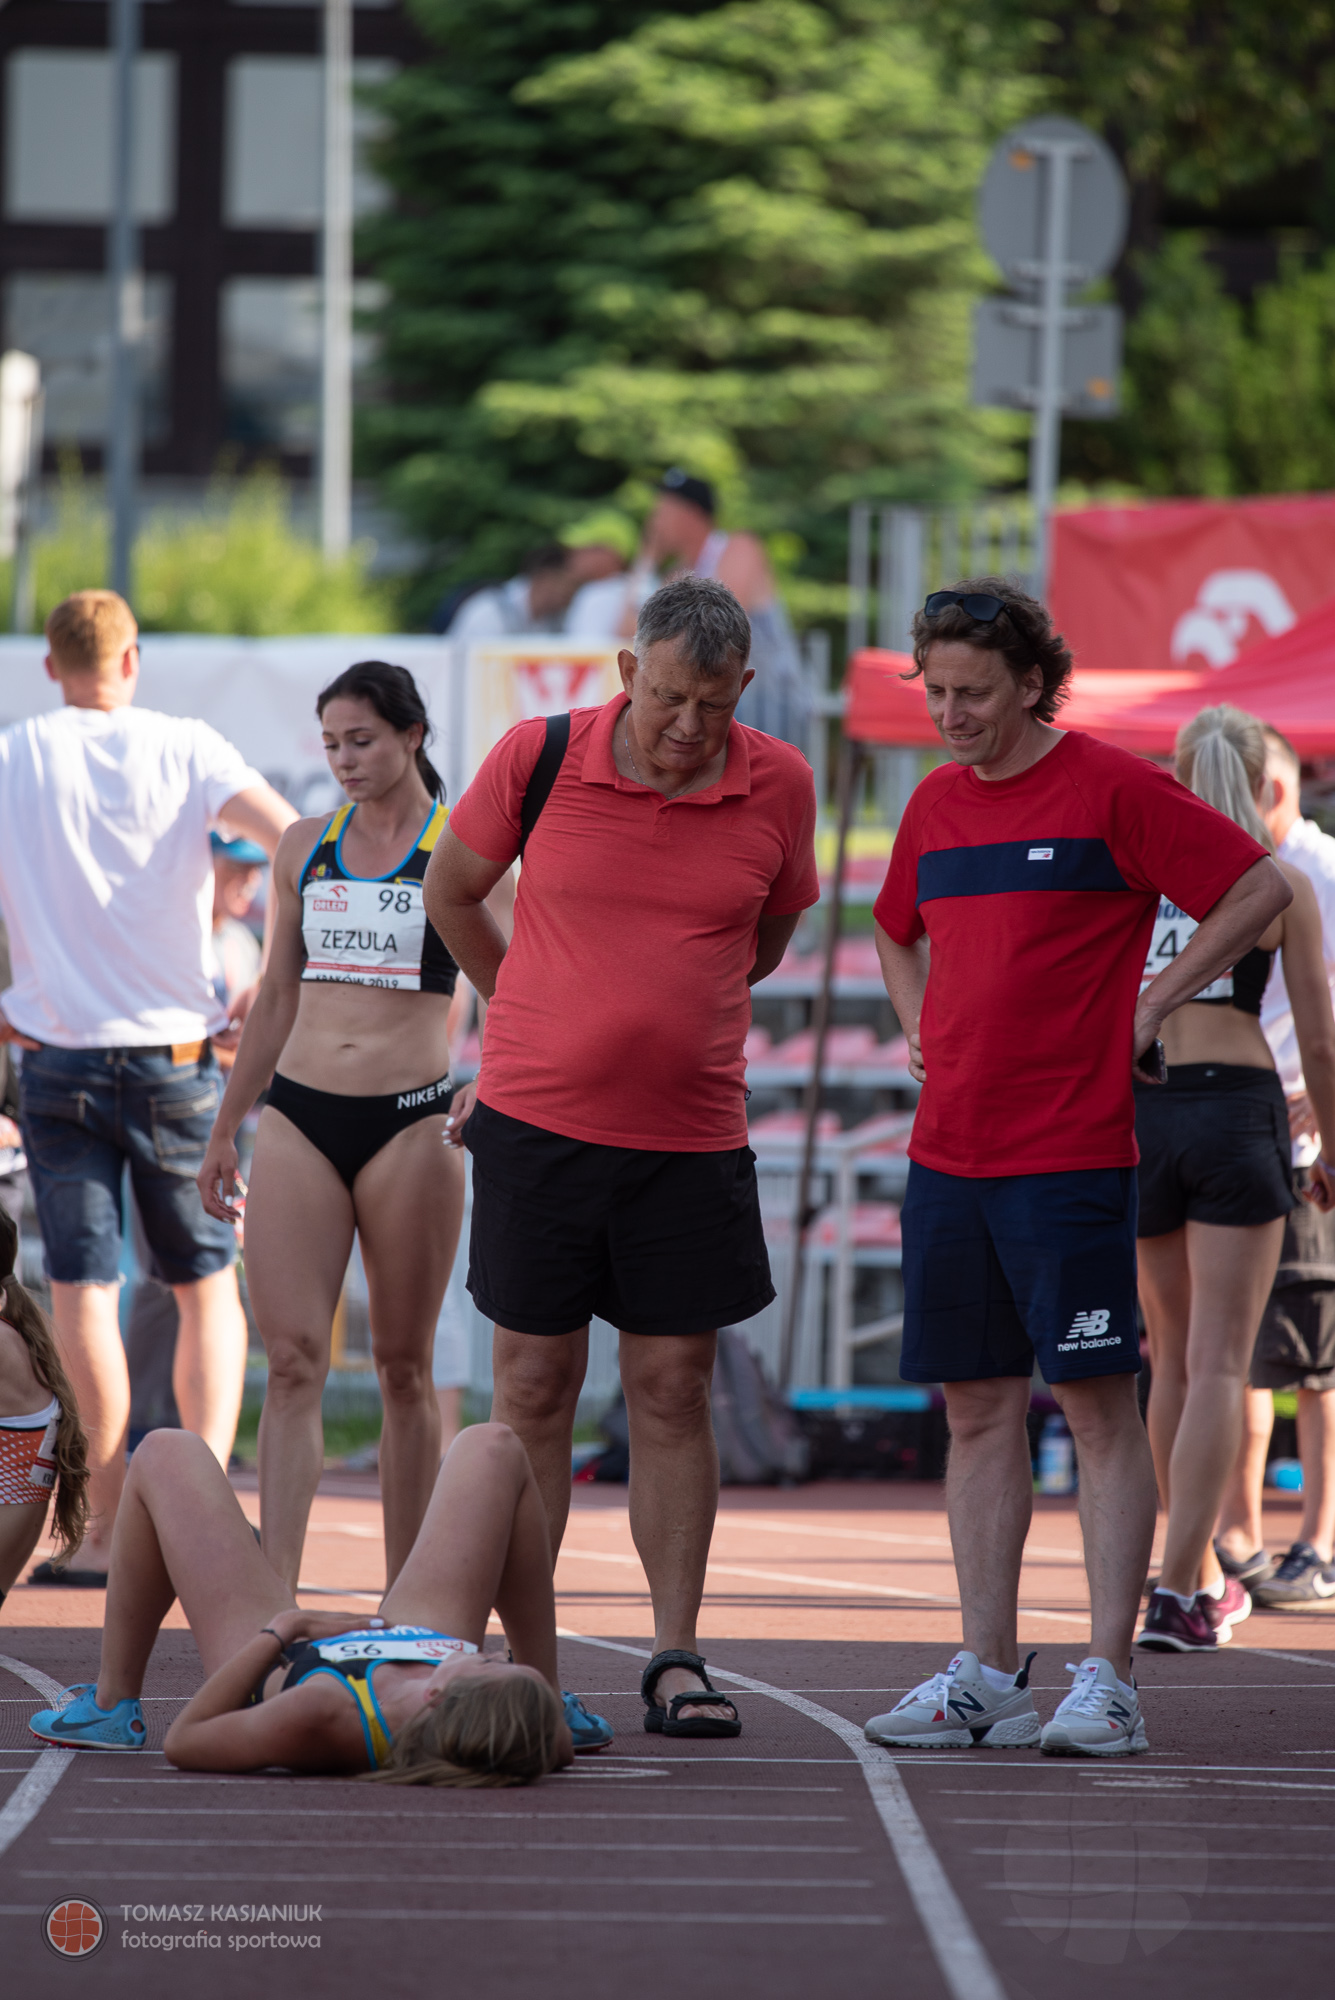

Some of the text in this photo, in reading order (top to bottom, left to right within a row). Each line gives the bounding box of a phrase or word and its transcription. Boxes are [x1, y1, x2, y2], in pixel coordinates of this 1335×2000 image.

[314, 900, 347, 912] ORLEN
[378, 889, 412, 914] 98
[320, 929, 398, 953] ZEZULA
[397, 1085, 436, 1110] NIKE
[1057, 1336, 1122, 1352] new balance
